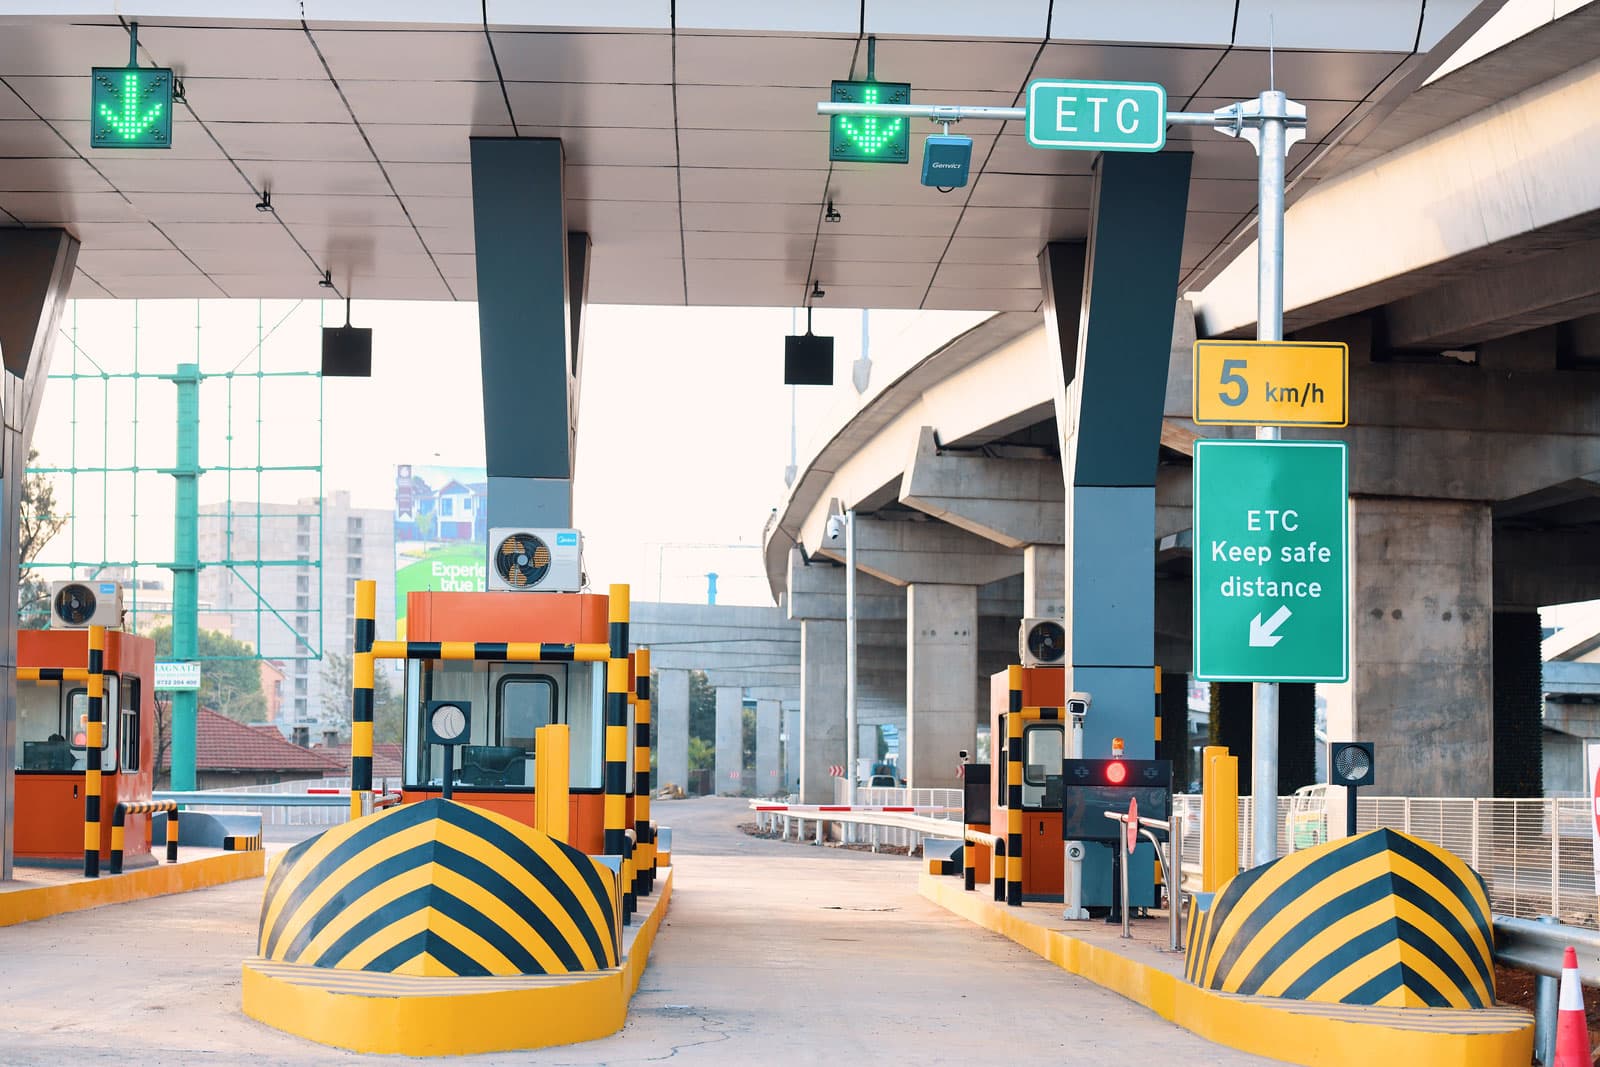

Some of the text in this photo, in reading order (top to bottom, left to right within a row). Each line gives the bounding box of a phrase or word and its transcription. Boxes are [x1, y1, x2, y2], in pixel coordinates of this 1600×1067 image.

[1056, 96, 1139, 134] ETC
[1218, 359, 1324, 407] 5 km/h
[1247, 509, 1299, 532] ETC
[1211, 540, 1331, 566] Keep safe
[440, 576, 474, 592] true
[1220, 576, 1322, 598] distance
